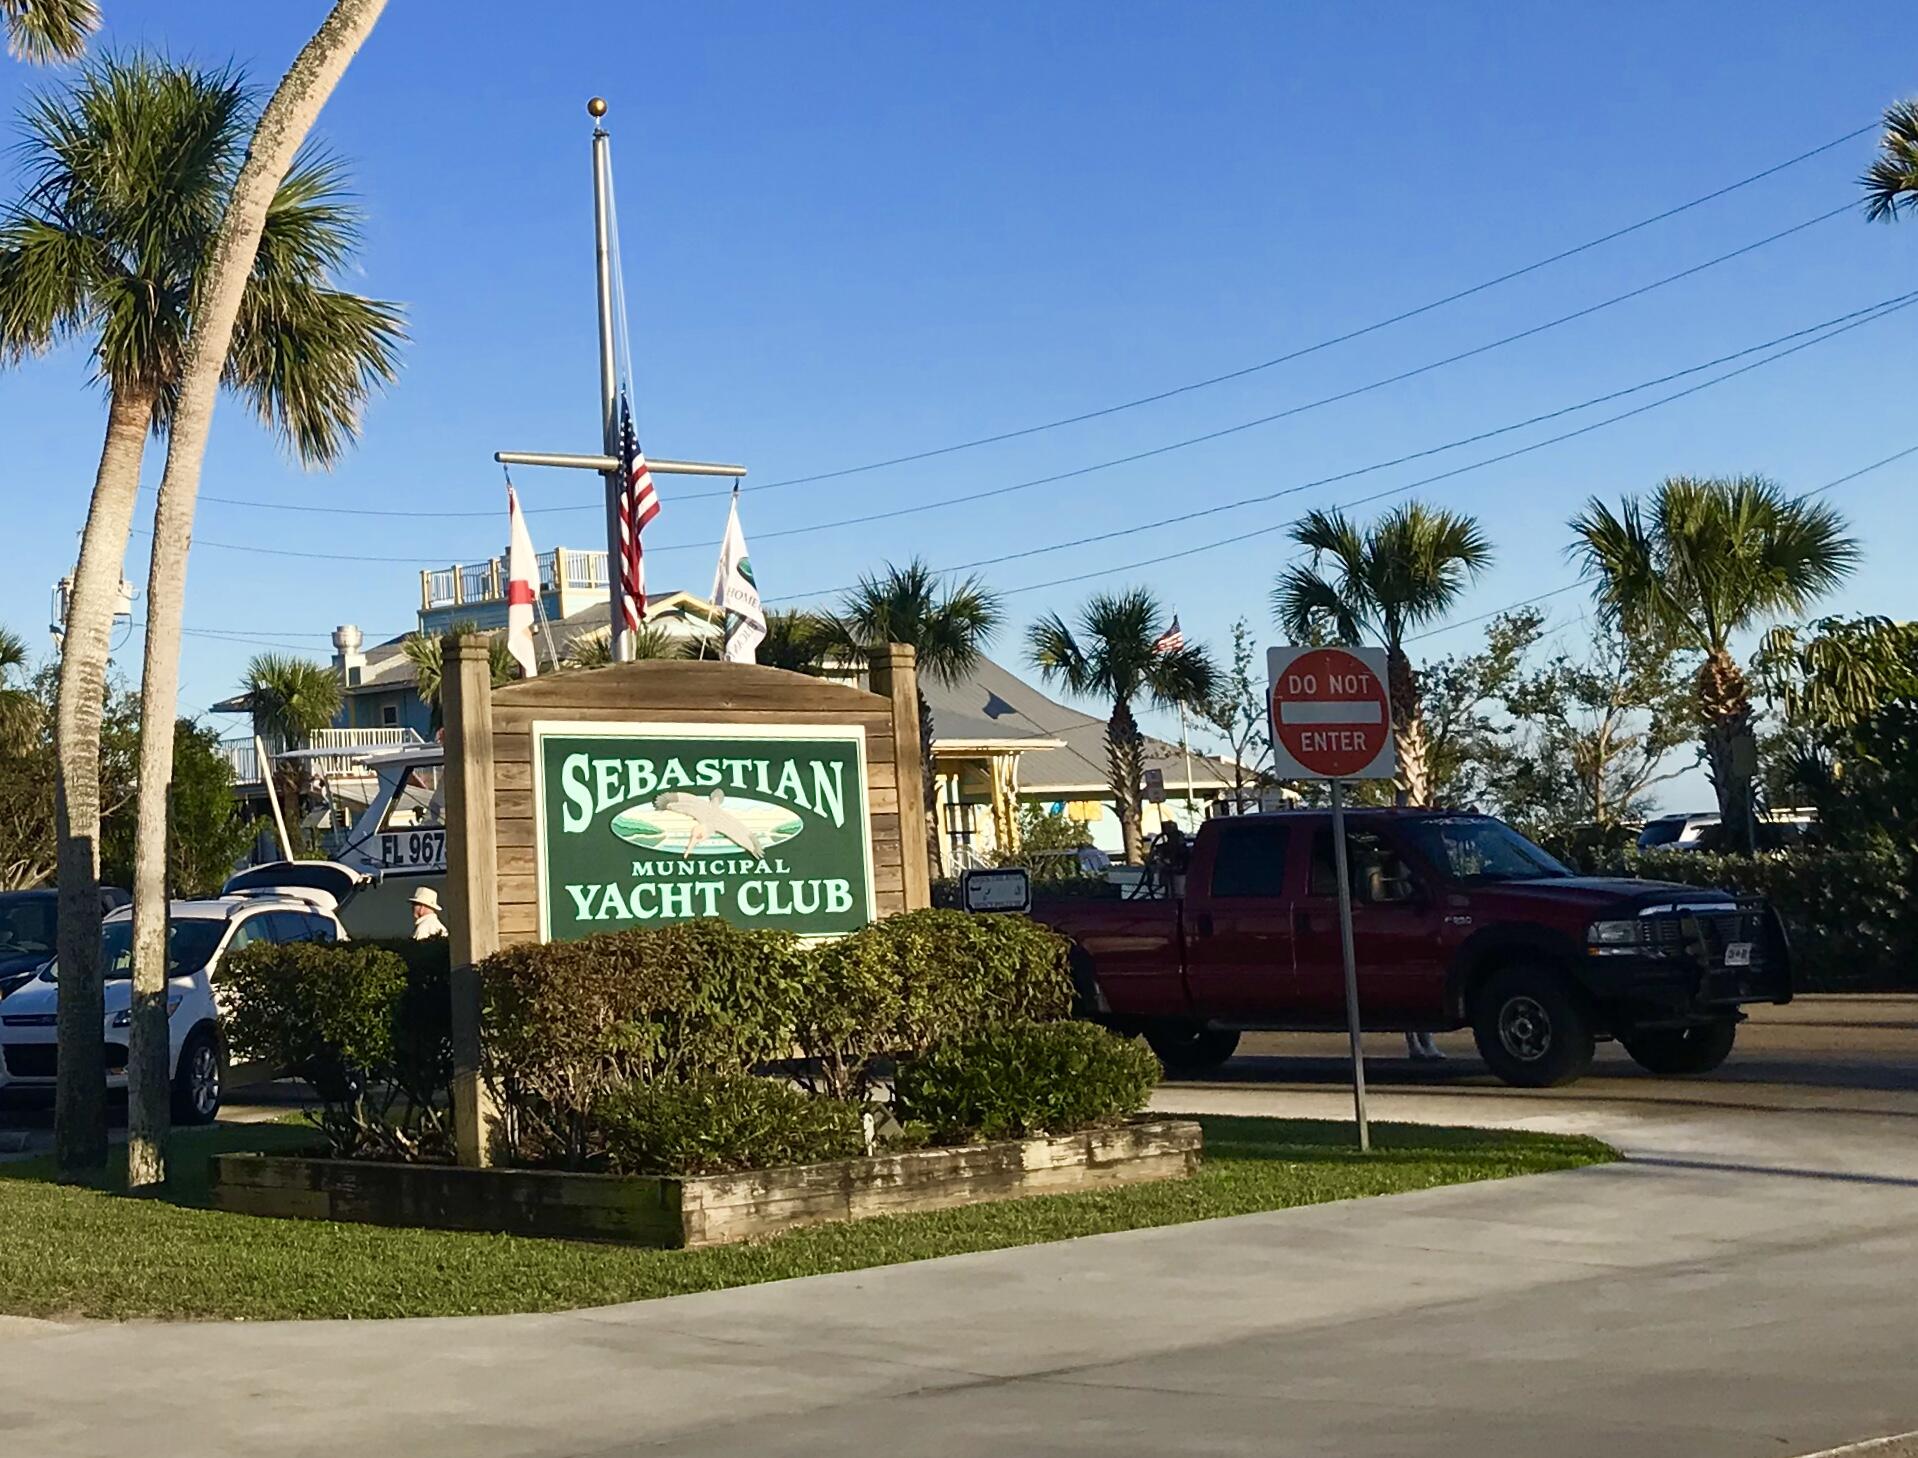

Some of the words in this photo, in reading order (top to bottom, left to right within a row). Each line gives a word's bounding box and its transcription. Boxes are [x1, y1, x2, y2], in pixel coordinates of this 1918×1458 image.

[726, 586, 757, 608] HOME
[1288, 674, 1317, 695] DO
[1328, 674, 1371, 694] NOT
[1300, 731, 1367, 752] ENTER
[561, 752, 845, 833] SEBASTIAN
[381, 834, 404, 865] FL
[409, 832, 446, 864] 967
[631, 857, 790, 878] MUNICIPAL
[565, 881, 725, 921] YACHT
[737, 878, 854, 917] CLUB
